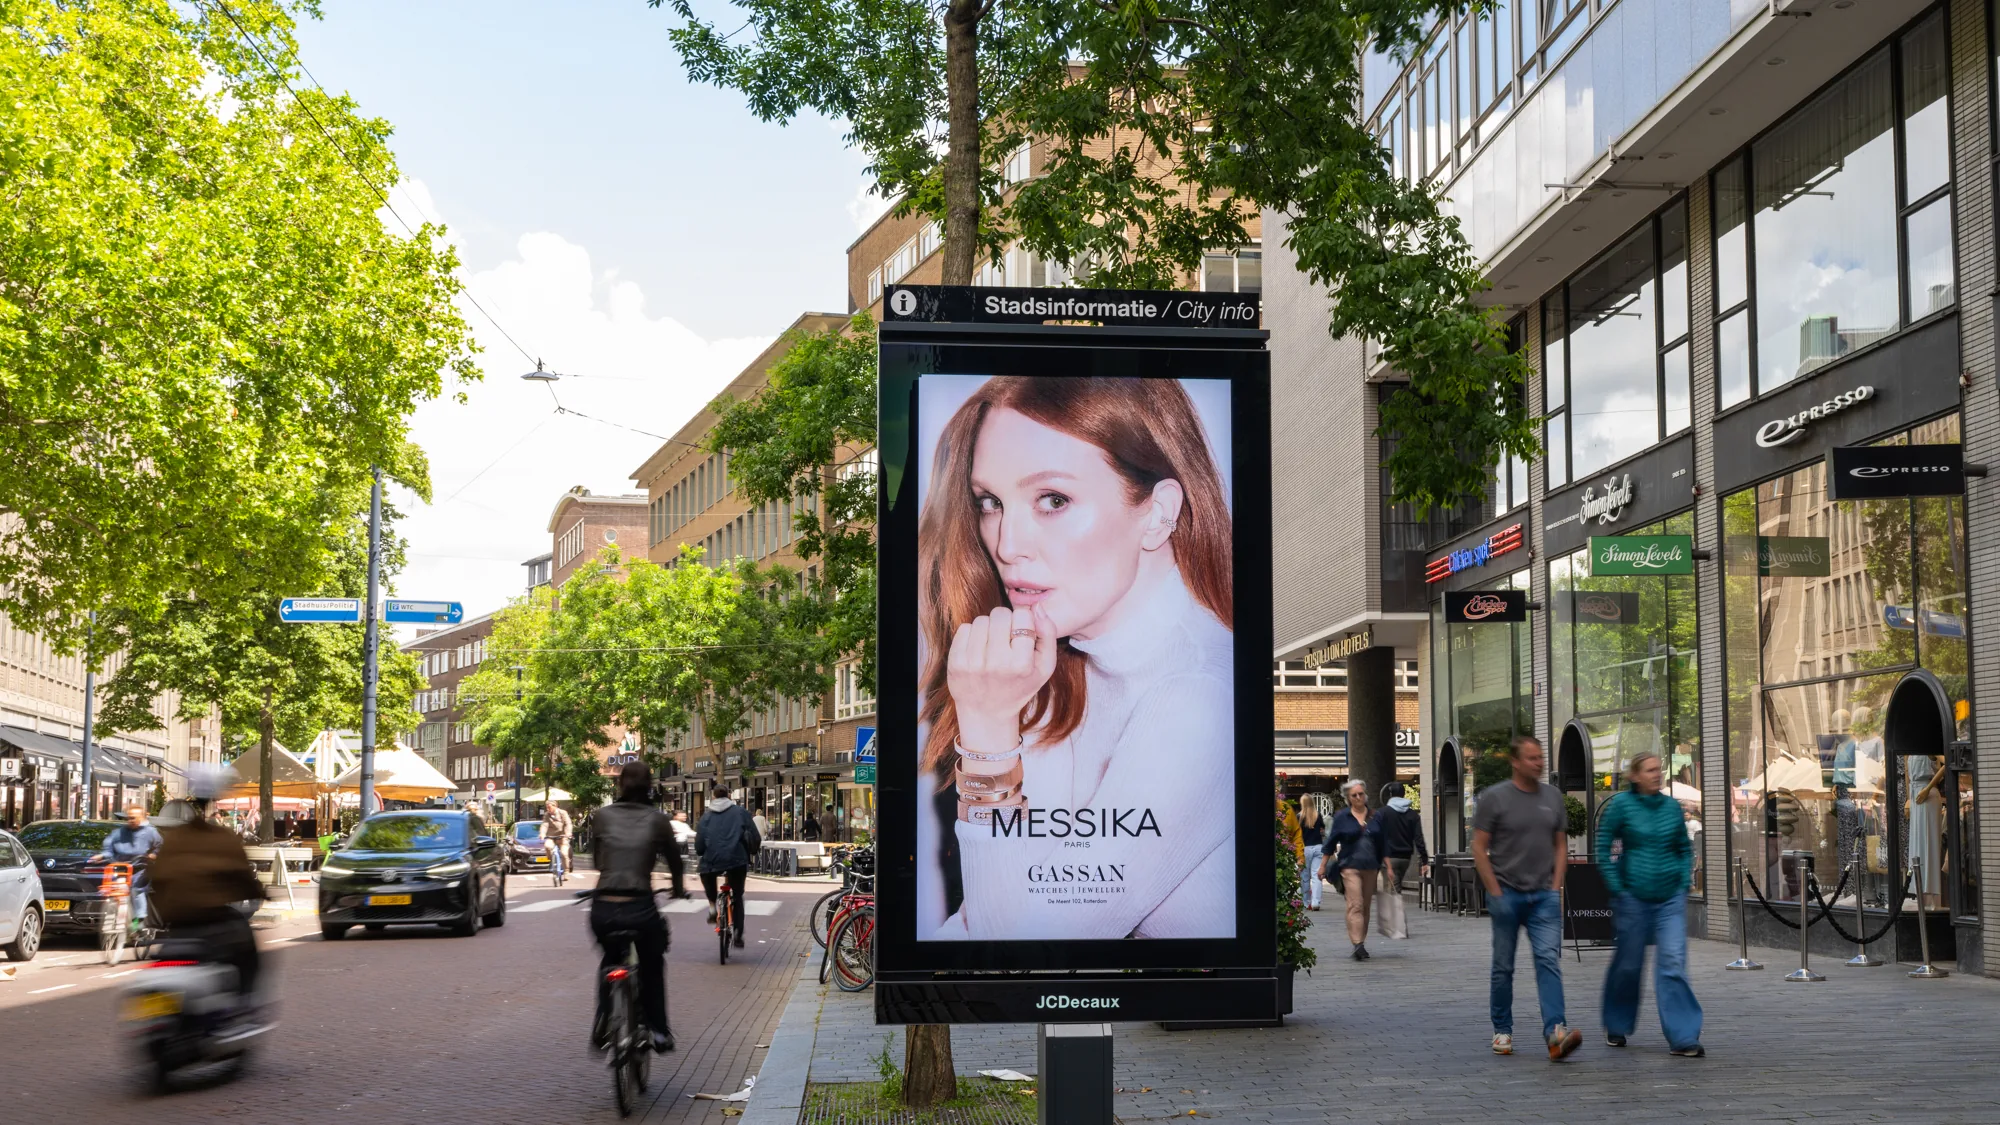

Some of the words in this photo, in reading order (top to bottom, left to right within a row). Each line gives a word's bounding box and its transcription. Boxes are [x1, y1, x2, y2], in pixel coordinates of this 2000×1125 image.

[984, 295, 1158, 318] Stadsinformatie
[1177, 300, 1216, 323] City
[1219, 302, 1255, 321] info
[294, 601, 355, 610] Stadhuis/Politie
[1340, 632, 1369, 657] HOTELS
[992, 808, 1162, 838] MESSIKA
[1028, 864, 1126, 883] GASSAN
[1567, 909, 1613, 917] EXPRESSO
[1035, 995, 1120, 1009] JCDecaux
